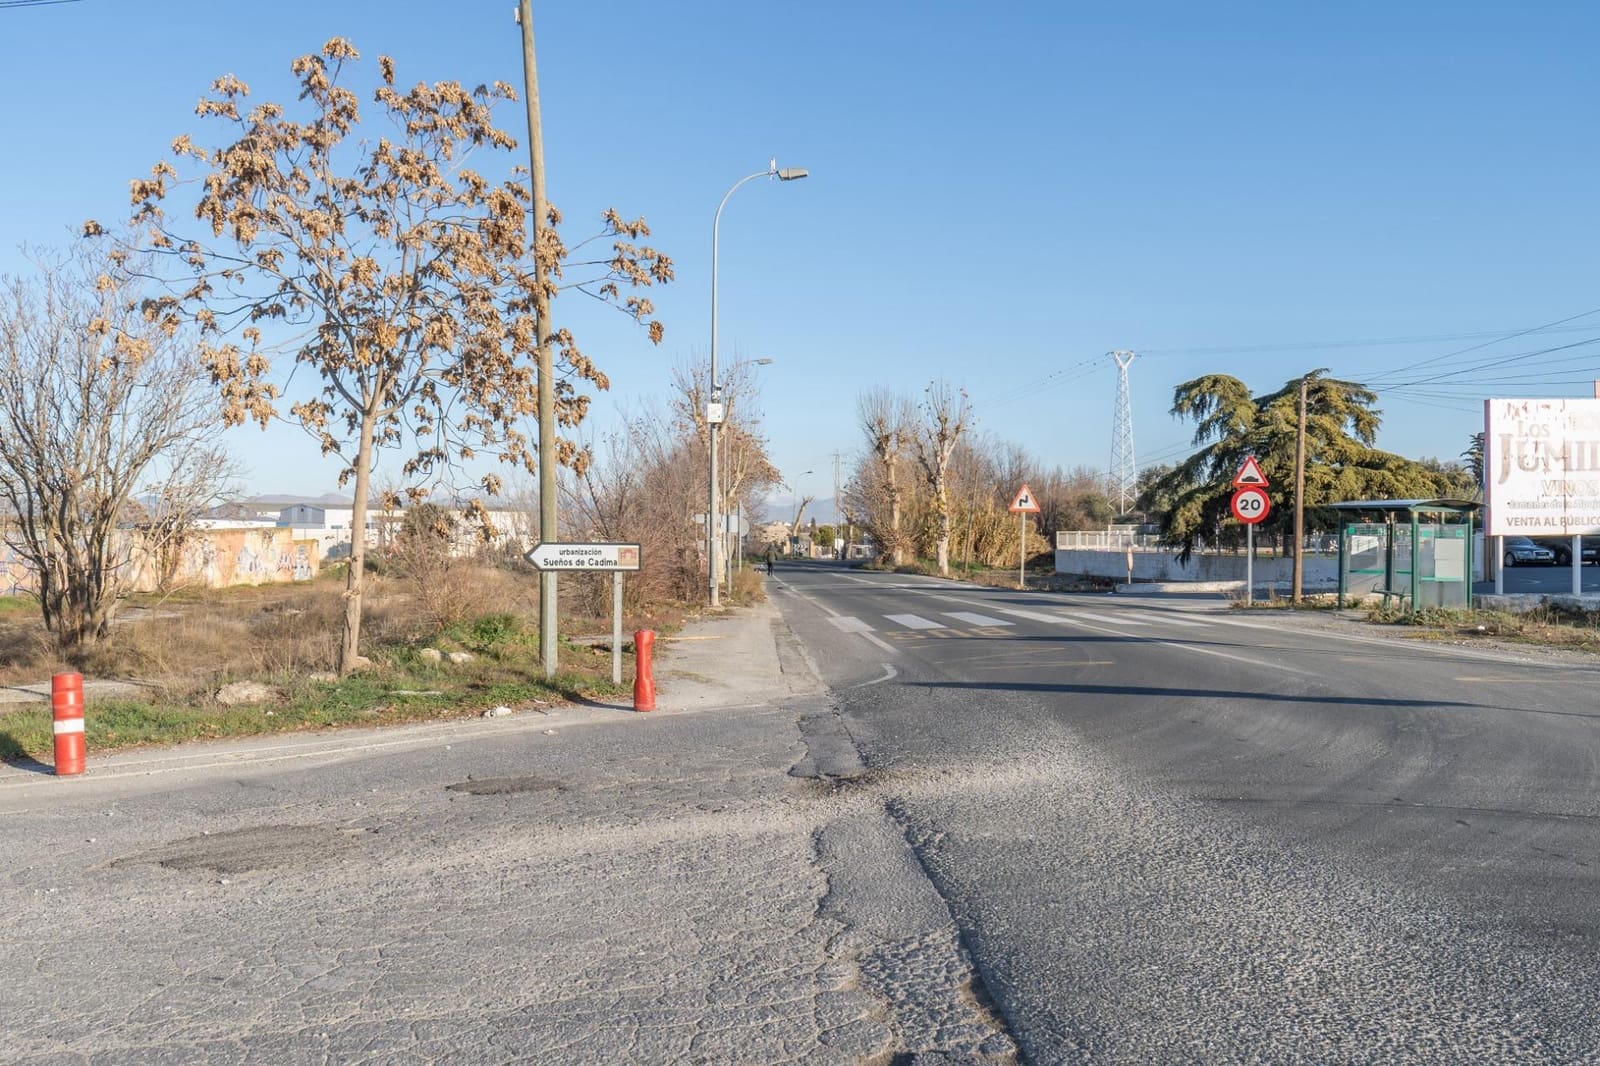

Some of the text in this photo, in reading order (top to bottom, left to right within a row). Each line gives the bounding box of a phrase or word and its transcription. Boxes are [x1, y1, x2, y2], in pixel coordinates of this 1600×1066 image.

[1542, 479, 1599, 496] VINOS
[1240, 499, 1261, 510] 20
[1506, 517, 1541, 526] VENTA
[1544, 517, 1558, 526] AL
[559, 547, 602, 556] urbanización
[543, 558, 618, 566] Sueños de Cadima
